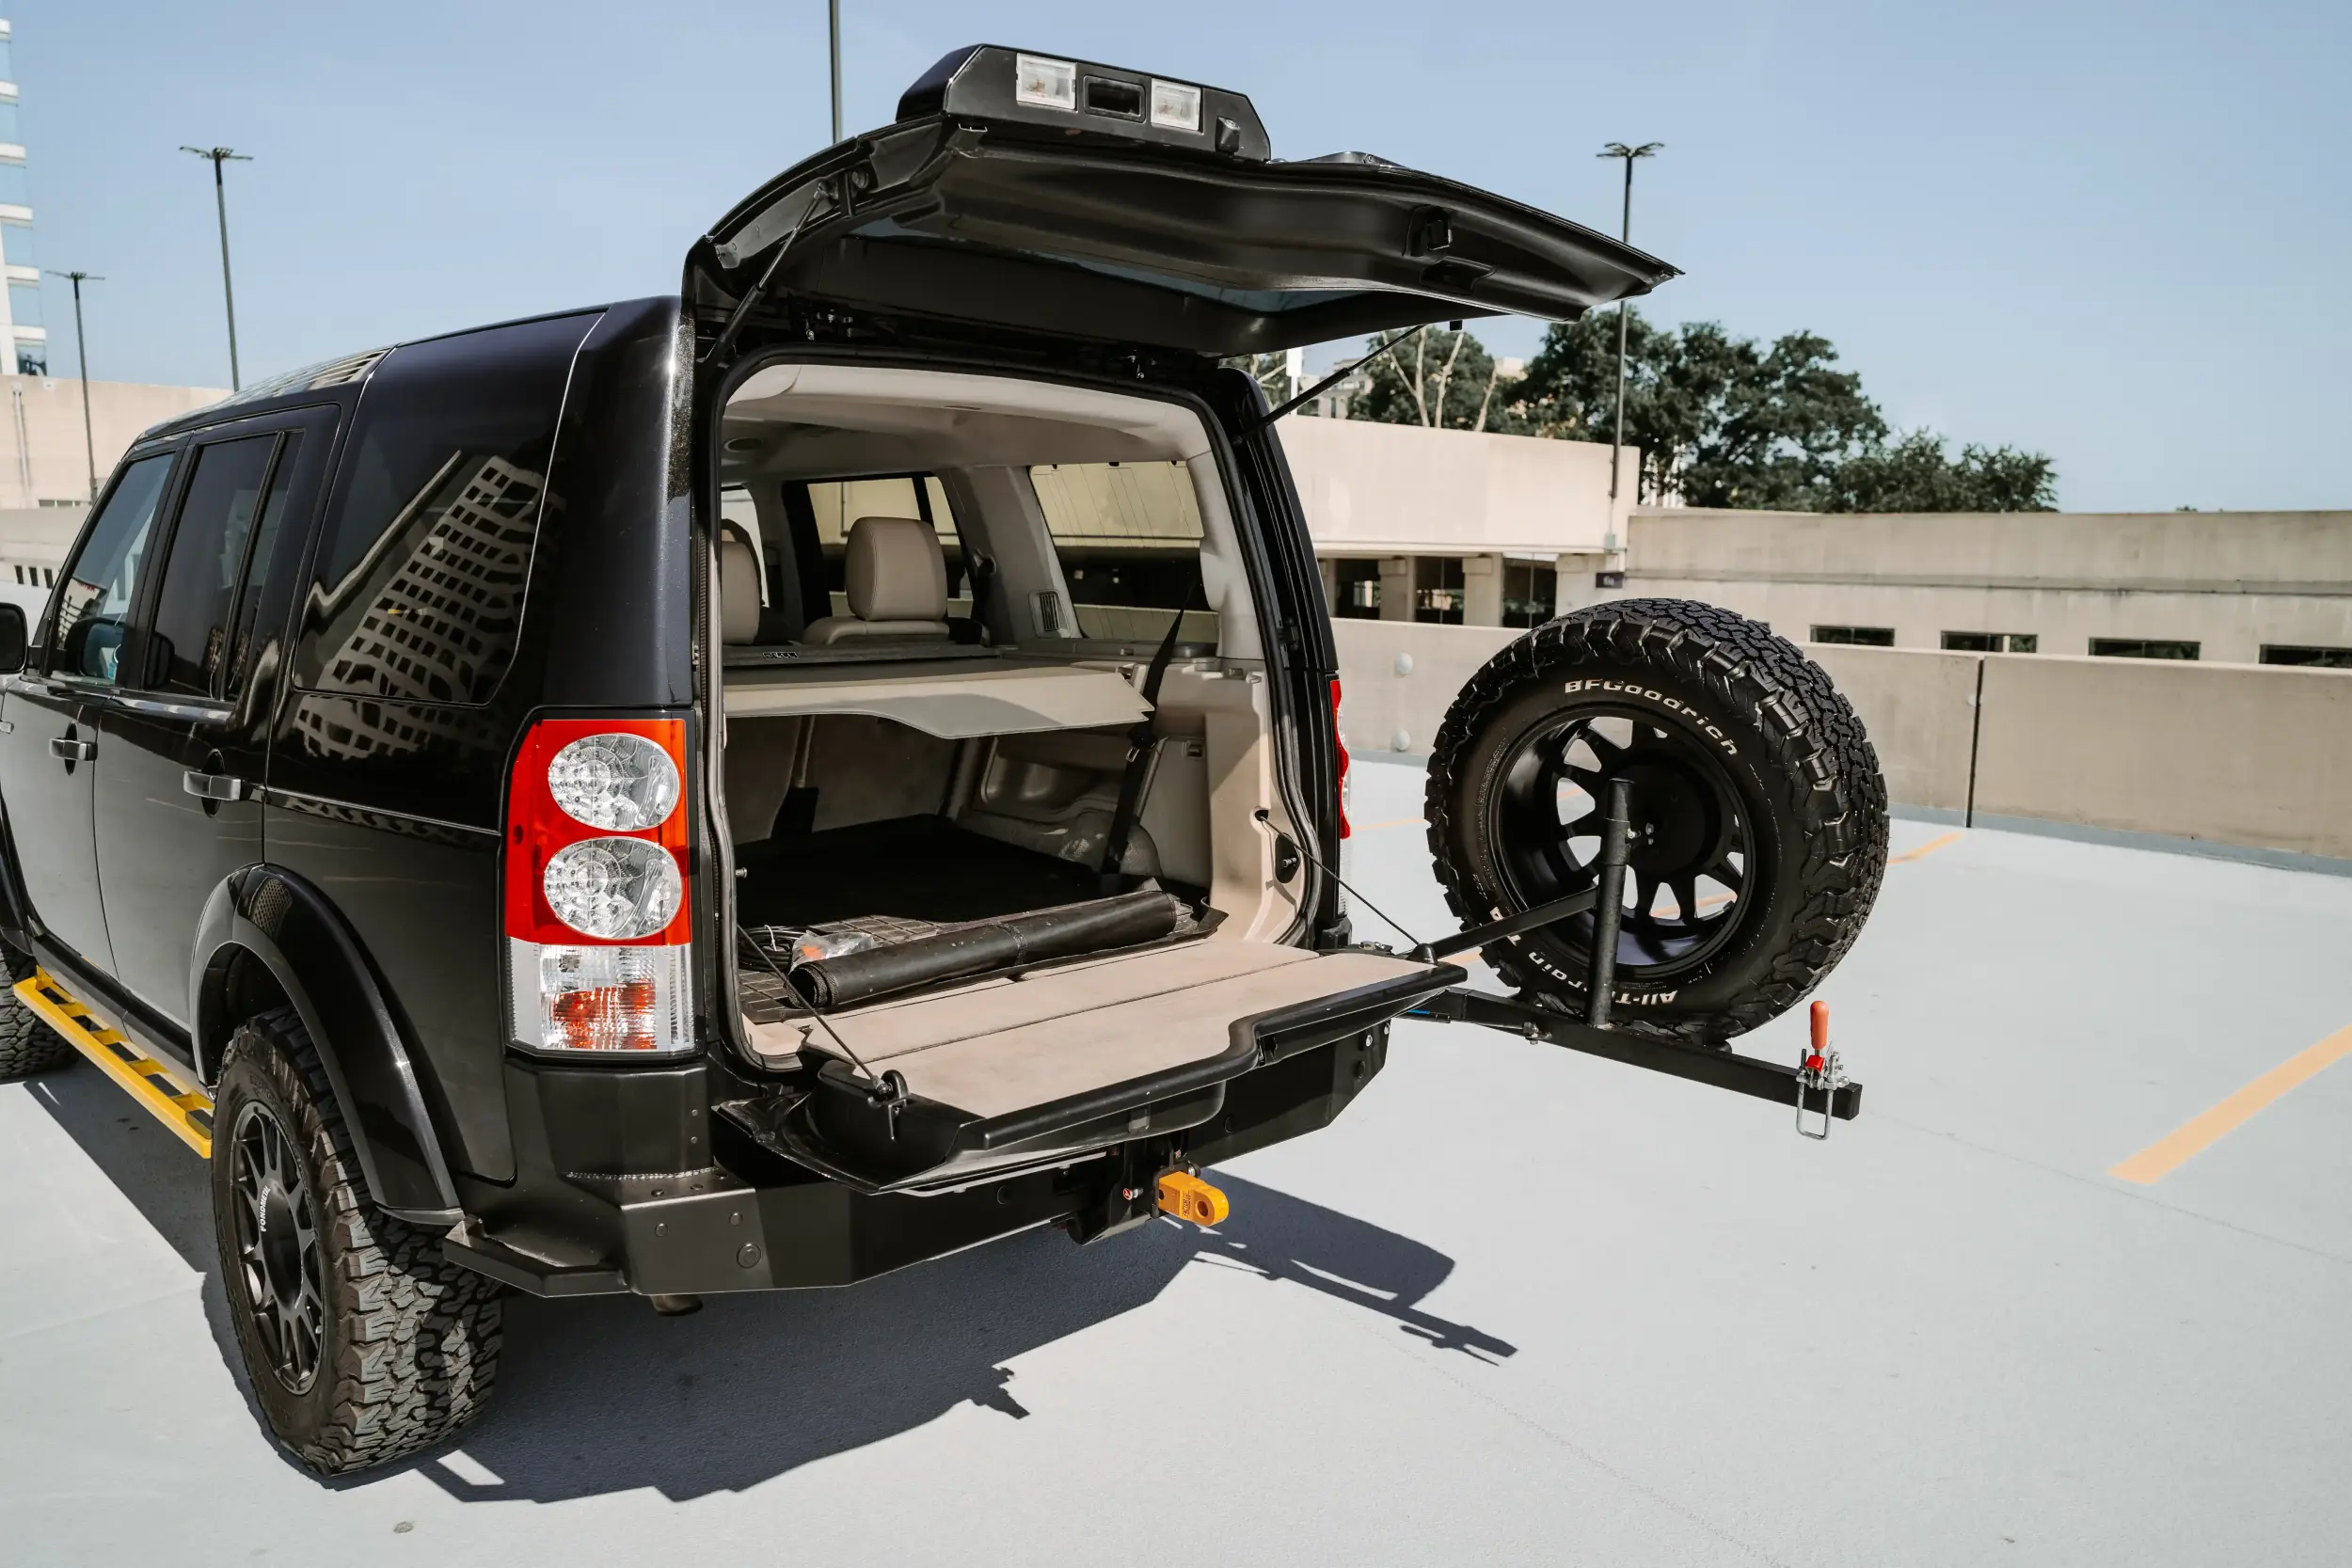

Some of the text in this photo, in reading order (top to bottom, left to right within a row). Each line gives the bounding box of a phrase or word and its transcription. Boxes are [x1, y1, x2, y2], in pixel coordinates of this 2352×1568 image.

[1564, 678, 1739, 755] BFGoodrich
[1528, 951, 1678, 1006] All-Train
[259, 1184, 272, 1232] FONDMETAL
